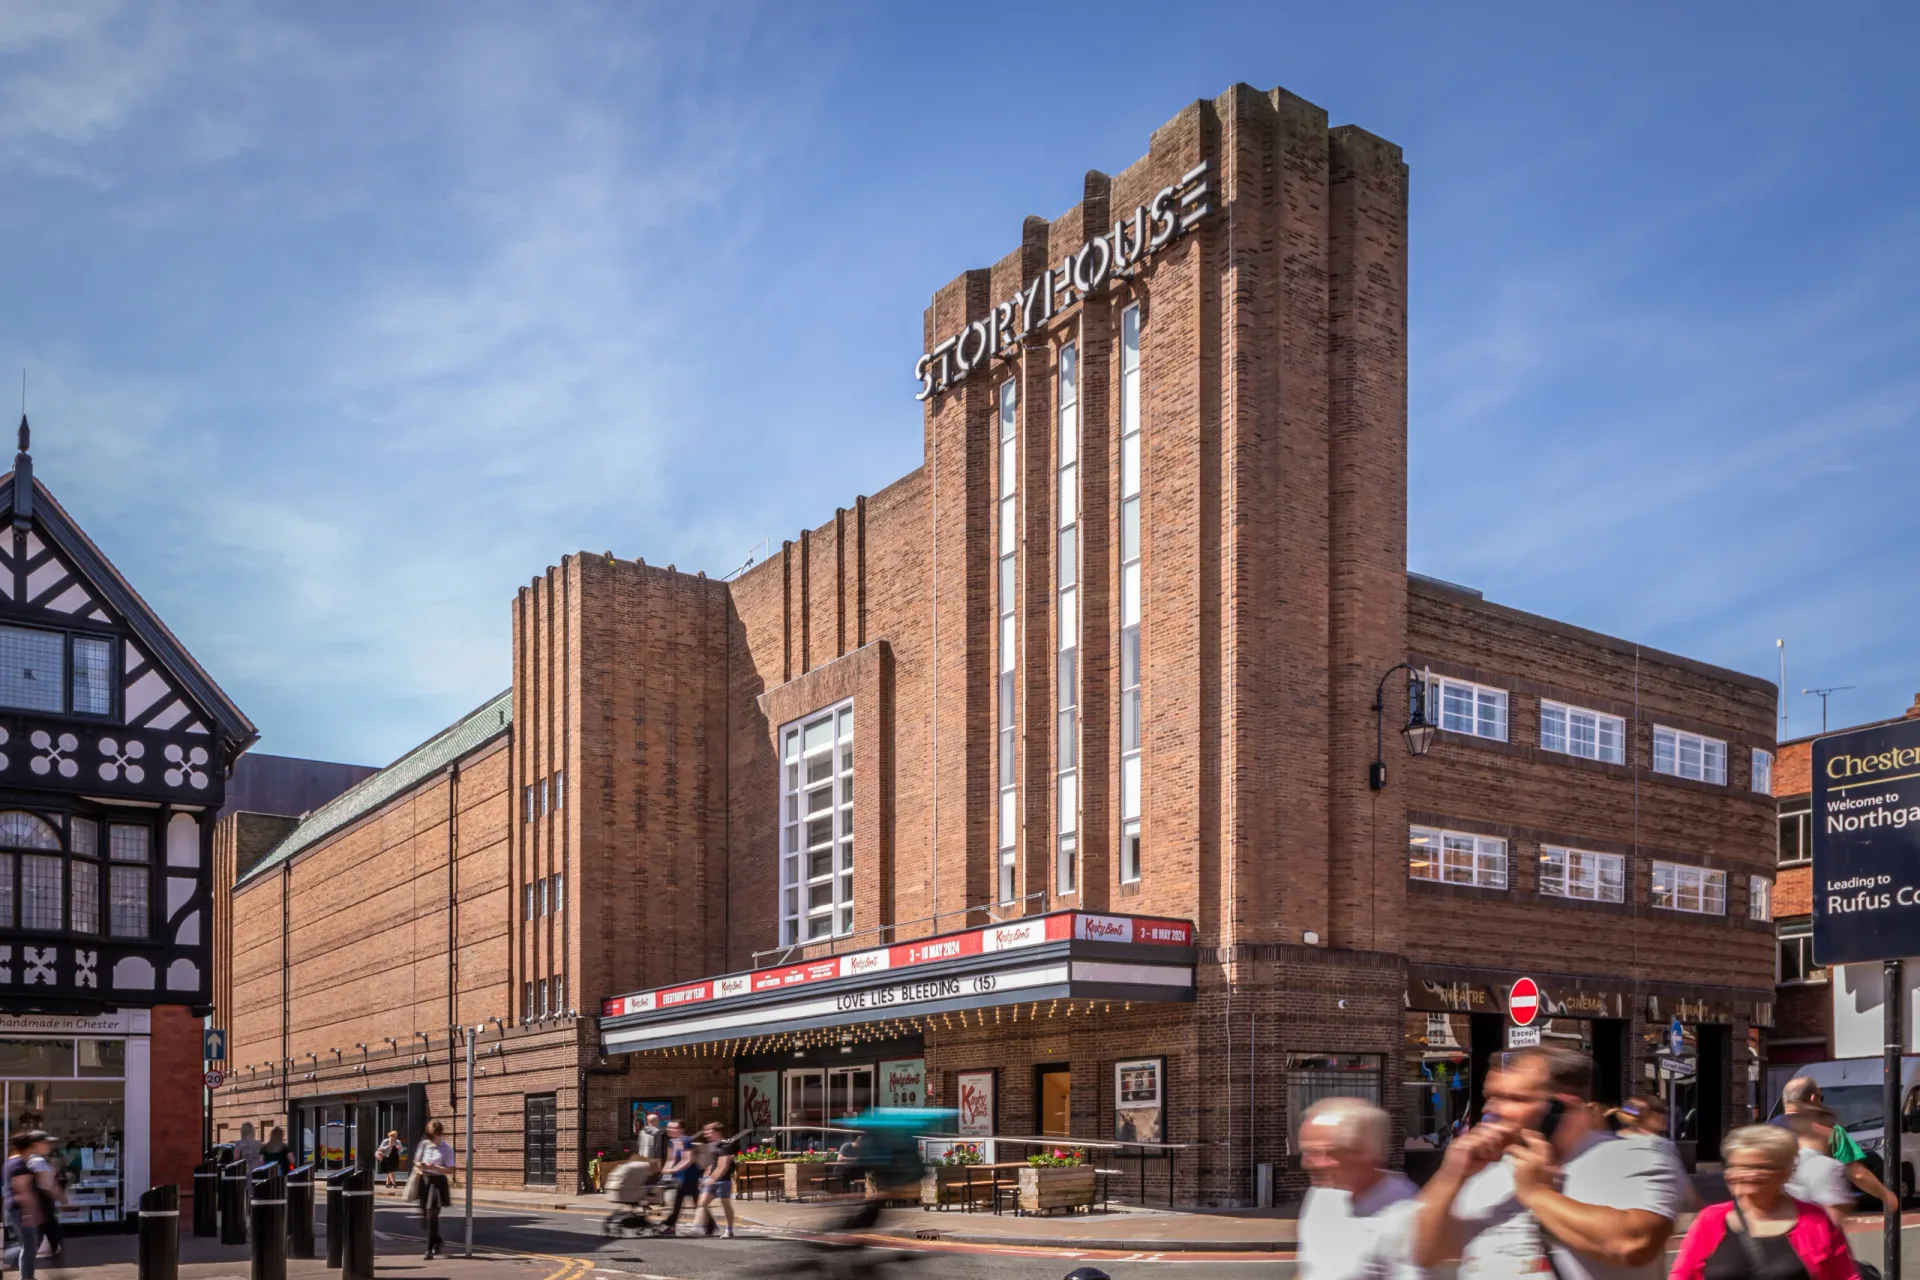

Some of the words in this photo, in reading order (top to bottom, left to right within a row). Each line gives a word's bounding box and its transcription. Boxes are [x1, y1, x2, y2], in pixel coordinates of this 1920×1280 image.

[914, 160, 1215, 401] STORYHOUSE
[1827, 796, 1883, 812] Welcome
[1885, 793, 1899, 803] to
[1827, 876, 1875, 891] Leading
[1877, 875, 1891, 885] to
[1828, 891, 1890, 914] Rufus
[1085, 918, 1105, 940] Kinky
[1105, 923, 1124, 936] Boots
[1141, 927, 1145, 939] 3
[1159, 929, 1171, 940] MAY
[1171, 930, 1185, 941] 2024
[910, 948, 915, 962] 3
[929, 943, 943, 959] MAY
[943, 940, 960, 957] 2024
[836, 992, 865, 1010] LOVE
[871, 987, 894, 1006] LIES
[902, 979, 960, 1001] BLEEDING
[973, 975, 996, 993] (15)
[1440, 988, 1485, 1004] THEATRE
[1566, 996, 1602, 1011] CINEMA
[0, 1018, 60, 1028] handmade
[63, 1018, 73, 1028] in
[76, 1018, 120, 1029] Chester
[1511, 1030, 1538, 1038] Except
[1512, 1038, 1536, 1046] cycles
[206, 1075, 221, 1084] 20
